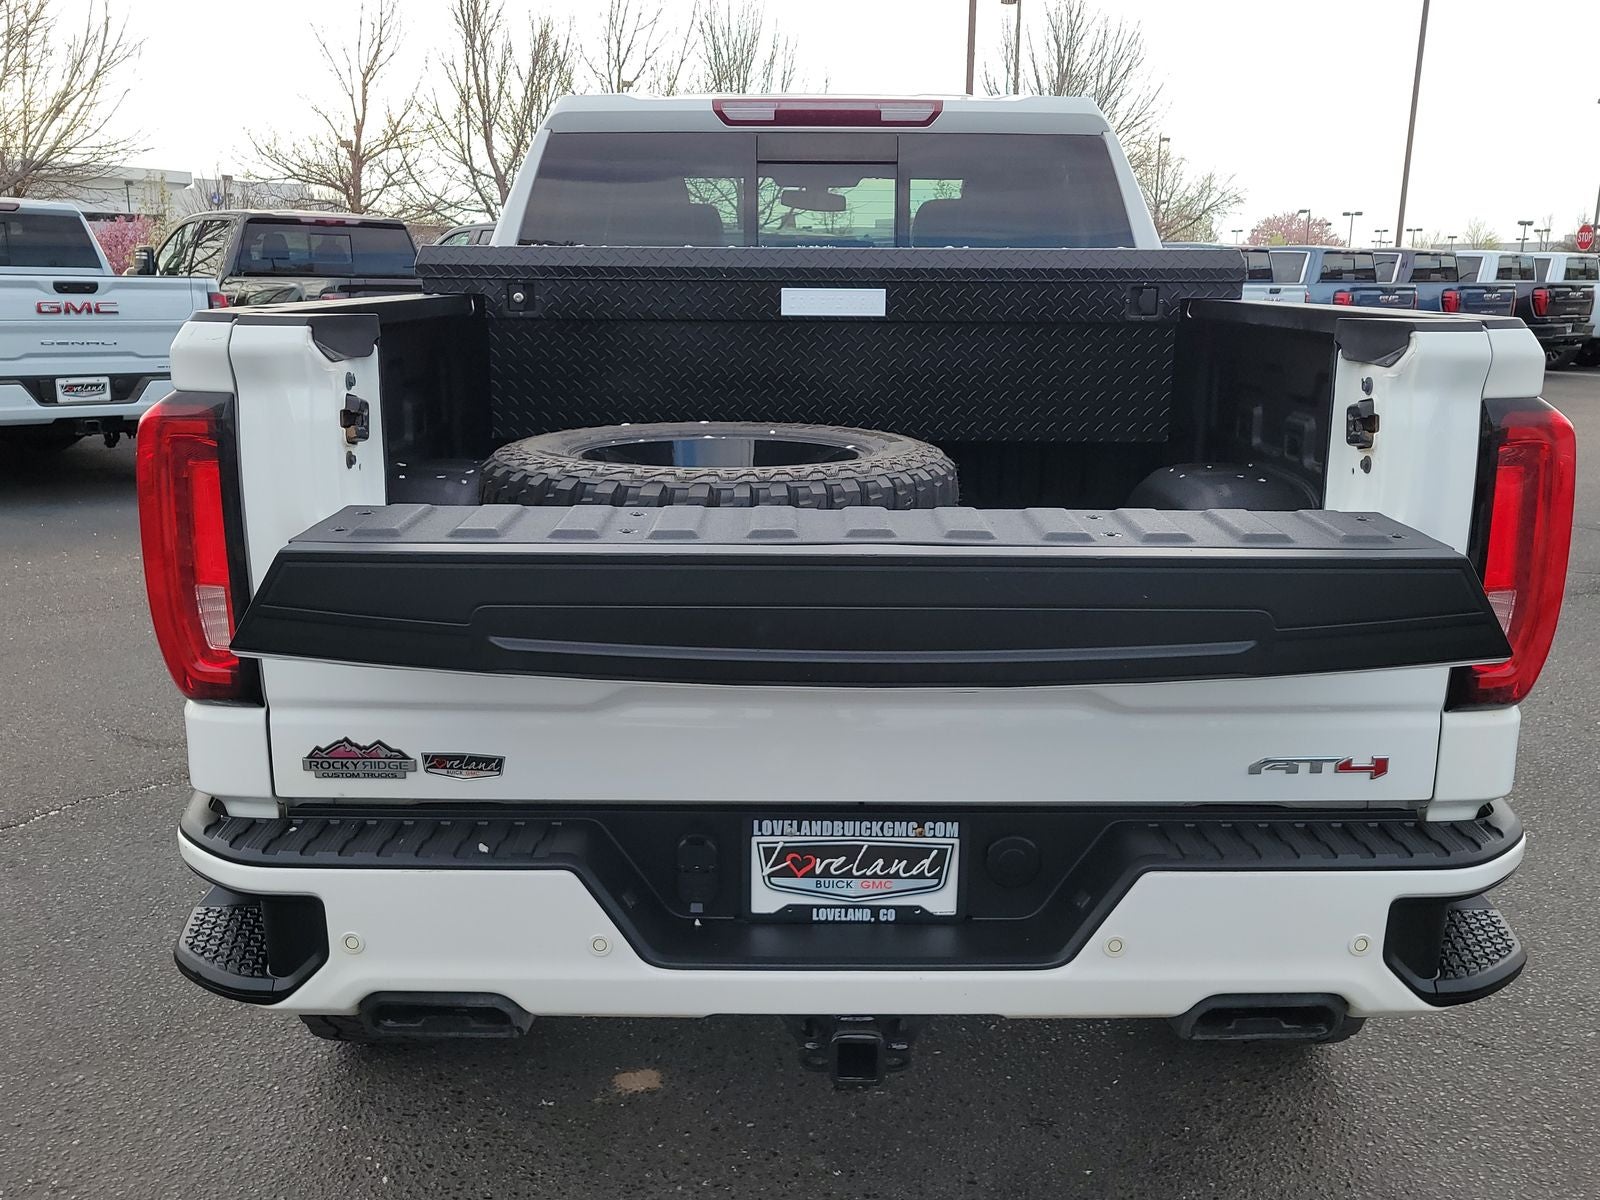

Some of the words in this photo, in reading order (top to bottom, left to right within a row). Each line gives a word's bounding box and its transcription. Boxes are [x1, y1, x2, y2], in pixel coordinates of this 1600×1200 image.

[1578, 231, 1593, 242] STOP
[35, 301, 119, 315] GMC
[309, 760, 360, 770] ROCKY
[1248, 755, 1389, 779] AT4
[753, 819, 959, 837] LOVELANDBUICKGMCCOM
[815, 879, 853, 889] BUICK
[860, 880, 893, 890] GMC
[812, 908, 875, 922] LOVELAND,
[879, 908, 896, 921] CO
